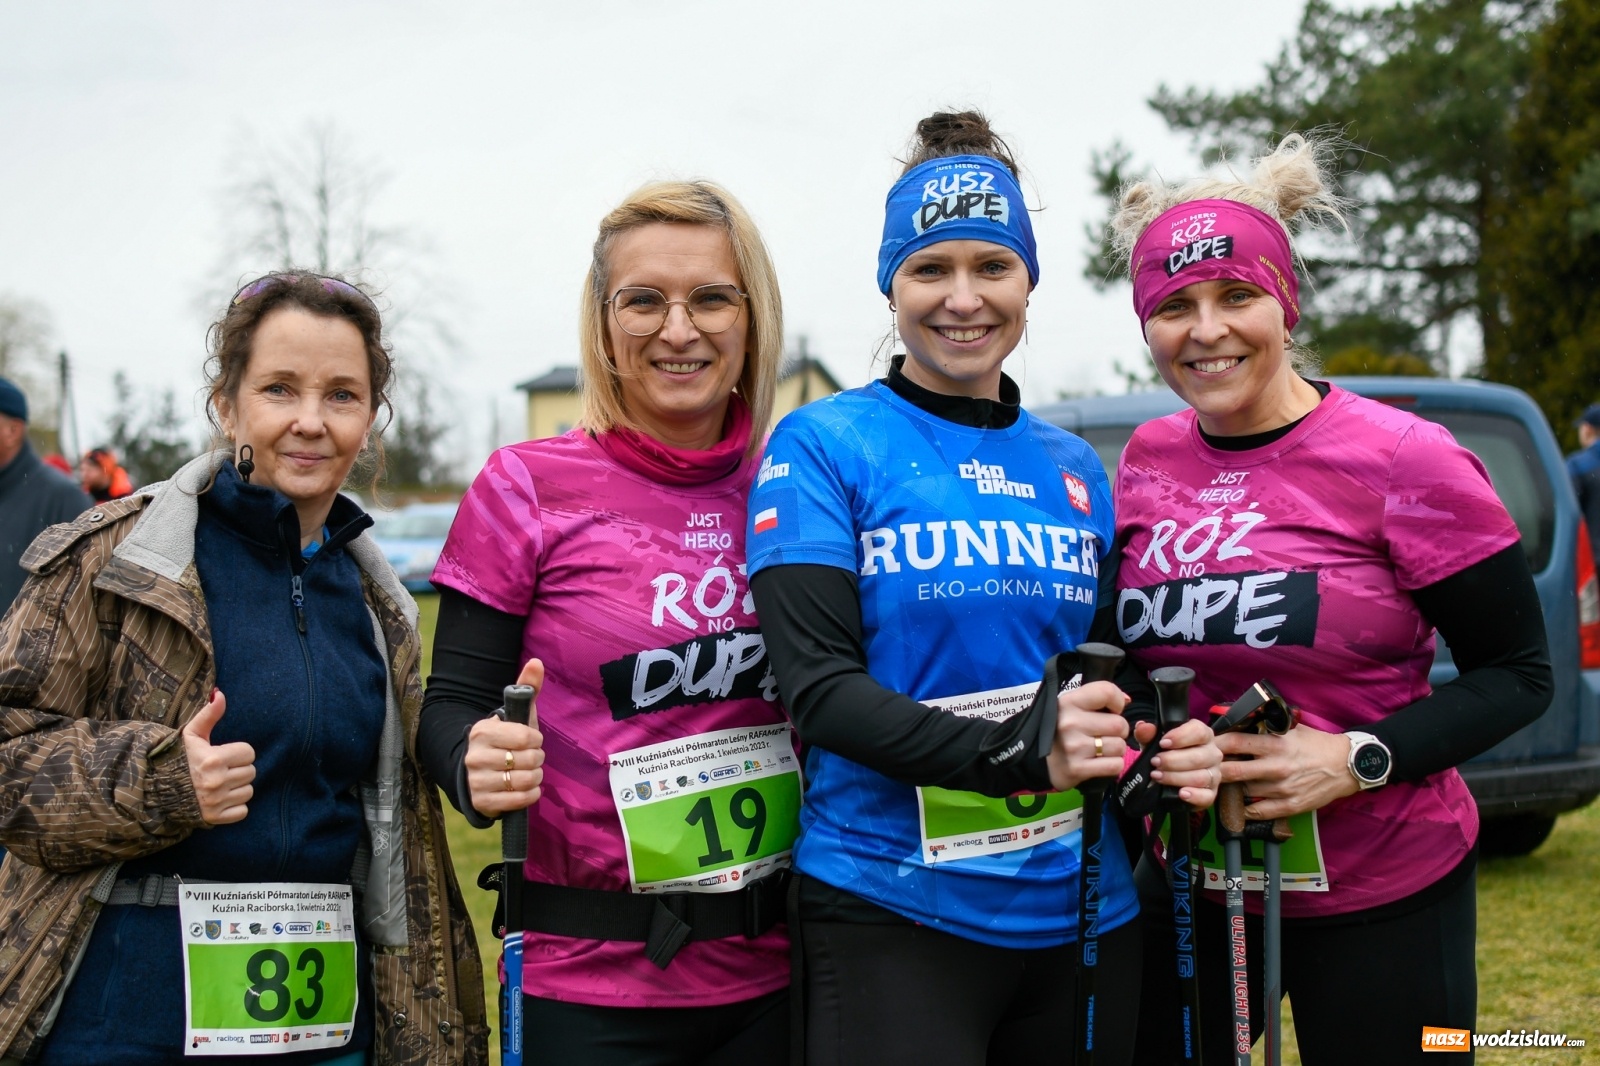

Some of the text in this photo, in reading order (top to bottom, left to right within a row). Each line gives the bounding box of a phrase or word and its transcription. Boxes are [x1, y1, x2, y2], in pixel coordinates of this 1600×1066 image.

[935, 164, 952, 173] just
[921, 171, 995, 202] RUSZ
[920, 192, 1003, 230] DUPĘ
[1189, 212, 1217, 222] HERO
[1171, 218, 1216, 246] RÓŻ
[1169, 235, 1227, 273] DUPĘ
[1058, 464, 1084, 480] POLAND
[1211, 471, 1250, 485] JUST
[1197, 488, 1246, 502] HERO
[686, 513, 722, 528] JUST
[684, 532, 732, 550] HERO
[860, 520, 1099, 579] RUNNER
[1139, 502, 1267, 574] RÓŻ
[1178, 562, 1205, 577] NO
[1053, 583, 1093, 605] TEAM
[708, 617, 736, 632] NO
[1116, 572, 1288, 649] DUPĘ
[631, 632, 780, 709] DUP
[987, 691, 1035, 707] Półmaraton
[618, 757, 635, 768] VIII
[636, 745, 685, 764] Kuźniański
[686, 737, 729, 752] Półmaraton
[729, 734, 748, 743] Leśny
[638, 762, 669, 775] Kuźnia
[669, 751, 717, 768] Raciborska,
[722, 744, 749, 756] kwietnia
[749, 741, 766, 751] 2023
[997, 740, 1025, 762] viking
[1121, 773, 1143, 799] viking
[684, 787, 767, 867] 19
[988, 831, 1018, 844] nowiny.pl
[193, 891, 211, 901] VIII
[213, 890, 266, 900] Kuźniański
[267, 890, 310, 900] Półmaraton
[310, 890, 328, 901] Leśny
[212, 904, 245, 913] Kuźnia
[247, 903, 295, 912] Raciborska,
[301, 903, 326, 912] kwietnia
[1083, 841, 1102, 966] VIKING
[1172, 855, 1194, 978] VIKING
[1231, 915, 1247, 966] ULTRA
[243, 948, 325, 1022] 83
[1234, 971, 1249, 1019] LIGHT
[1086, 994, 1095, 1051] TREKKING
[1182, 1005, 1192, 1059] TREKKING
[1236, 1022, 1250, 1054] 135
